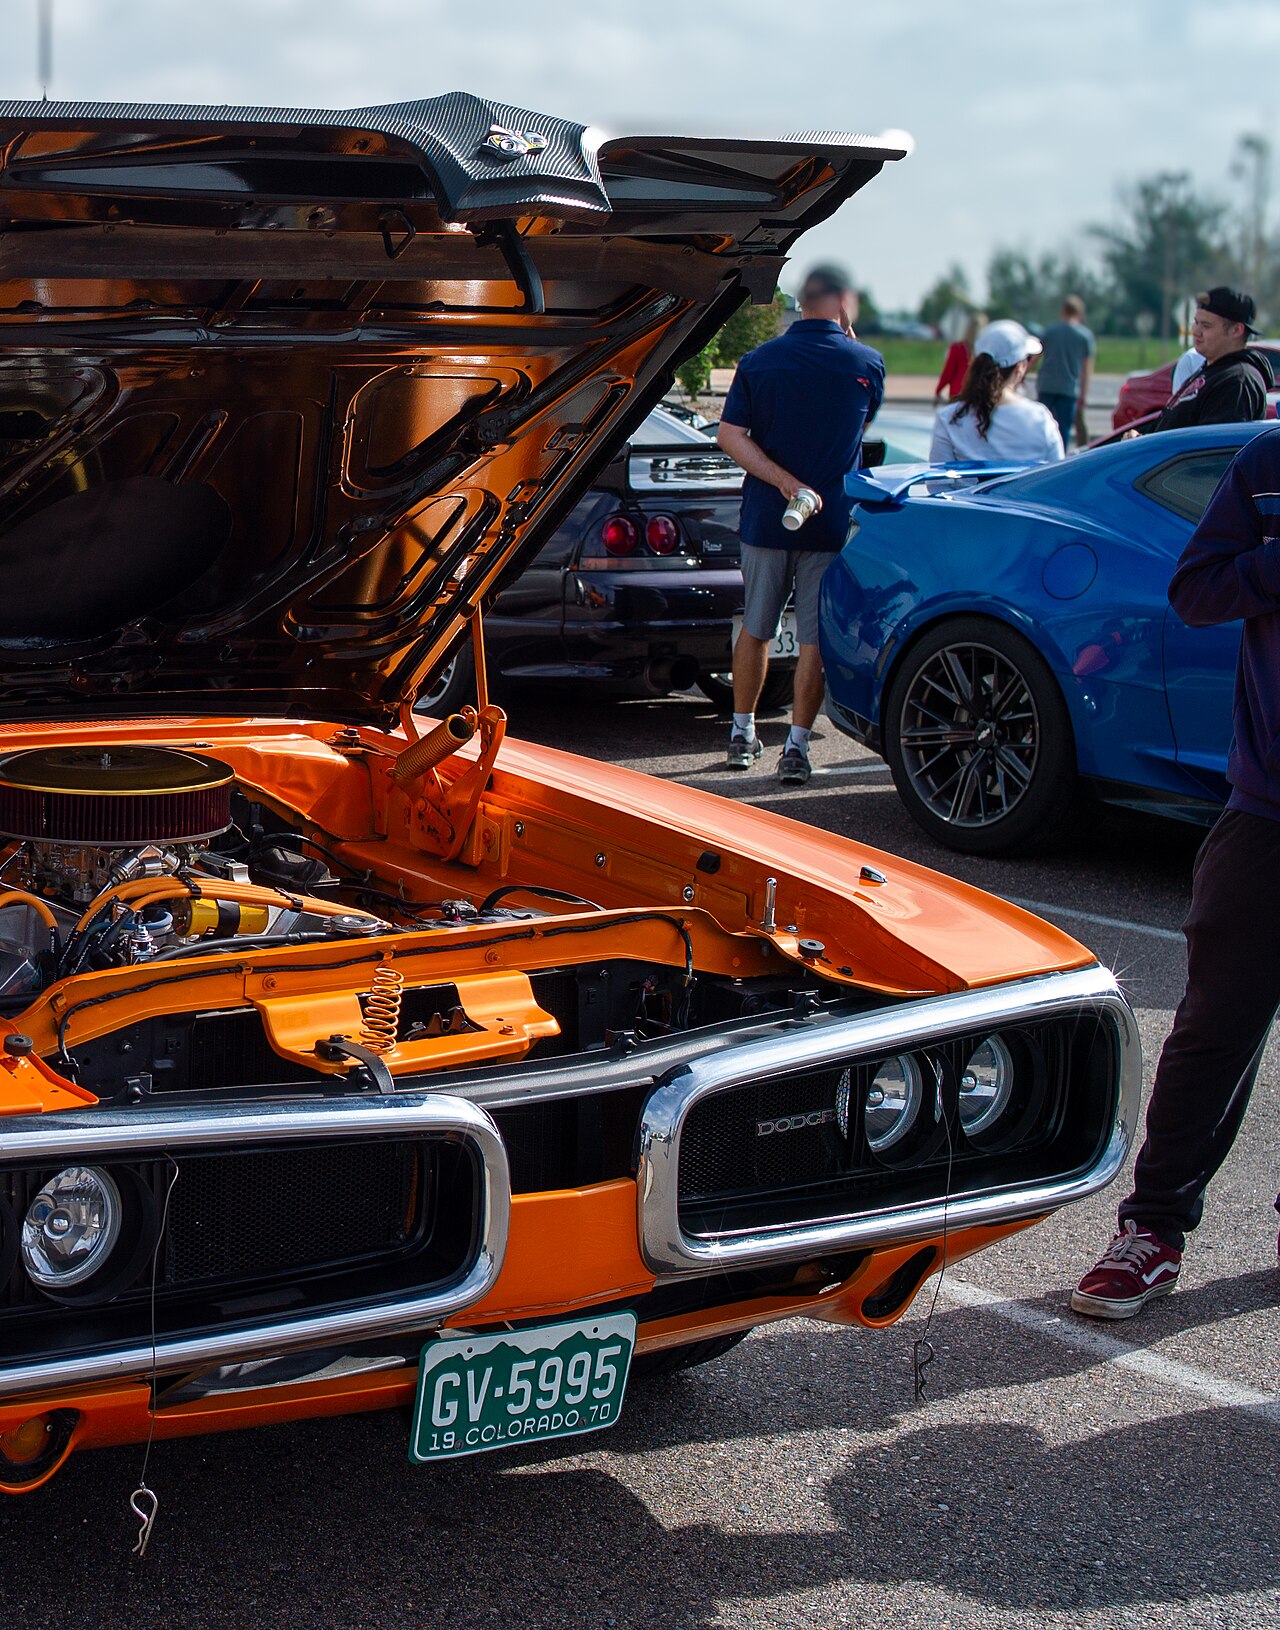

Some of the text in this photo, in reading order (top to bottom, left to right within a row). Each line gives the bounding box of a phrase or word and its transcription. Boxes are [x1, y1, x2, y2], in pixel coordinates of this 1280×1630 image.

[429, 1403, 611, 1451] 19 COLORADO 70
